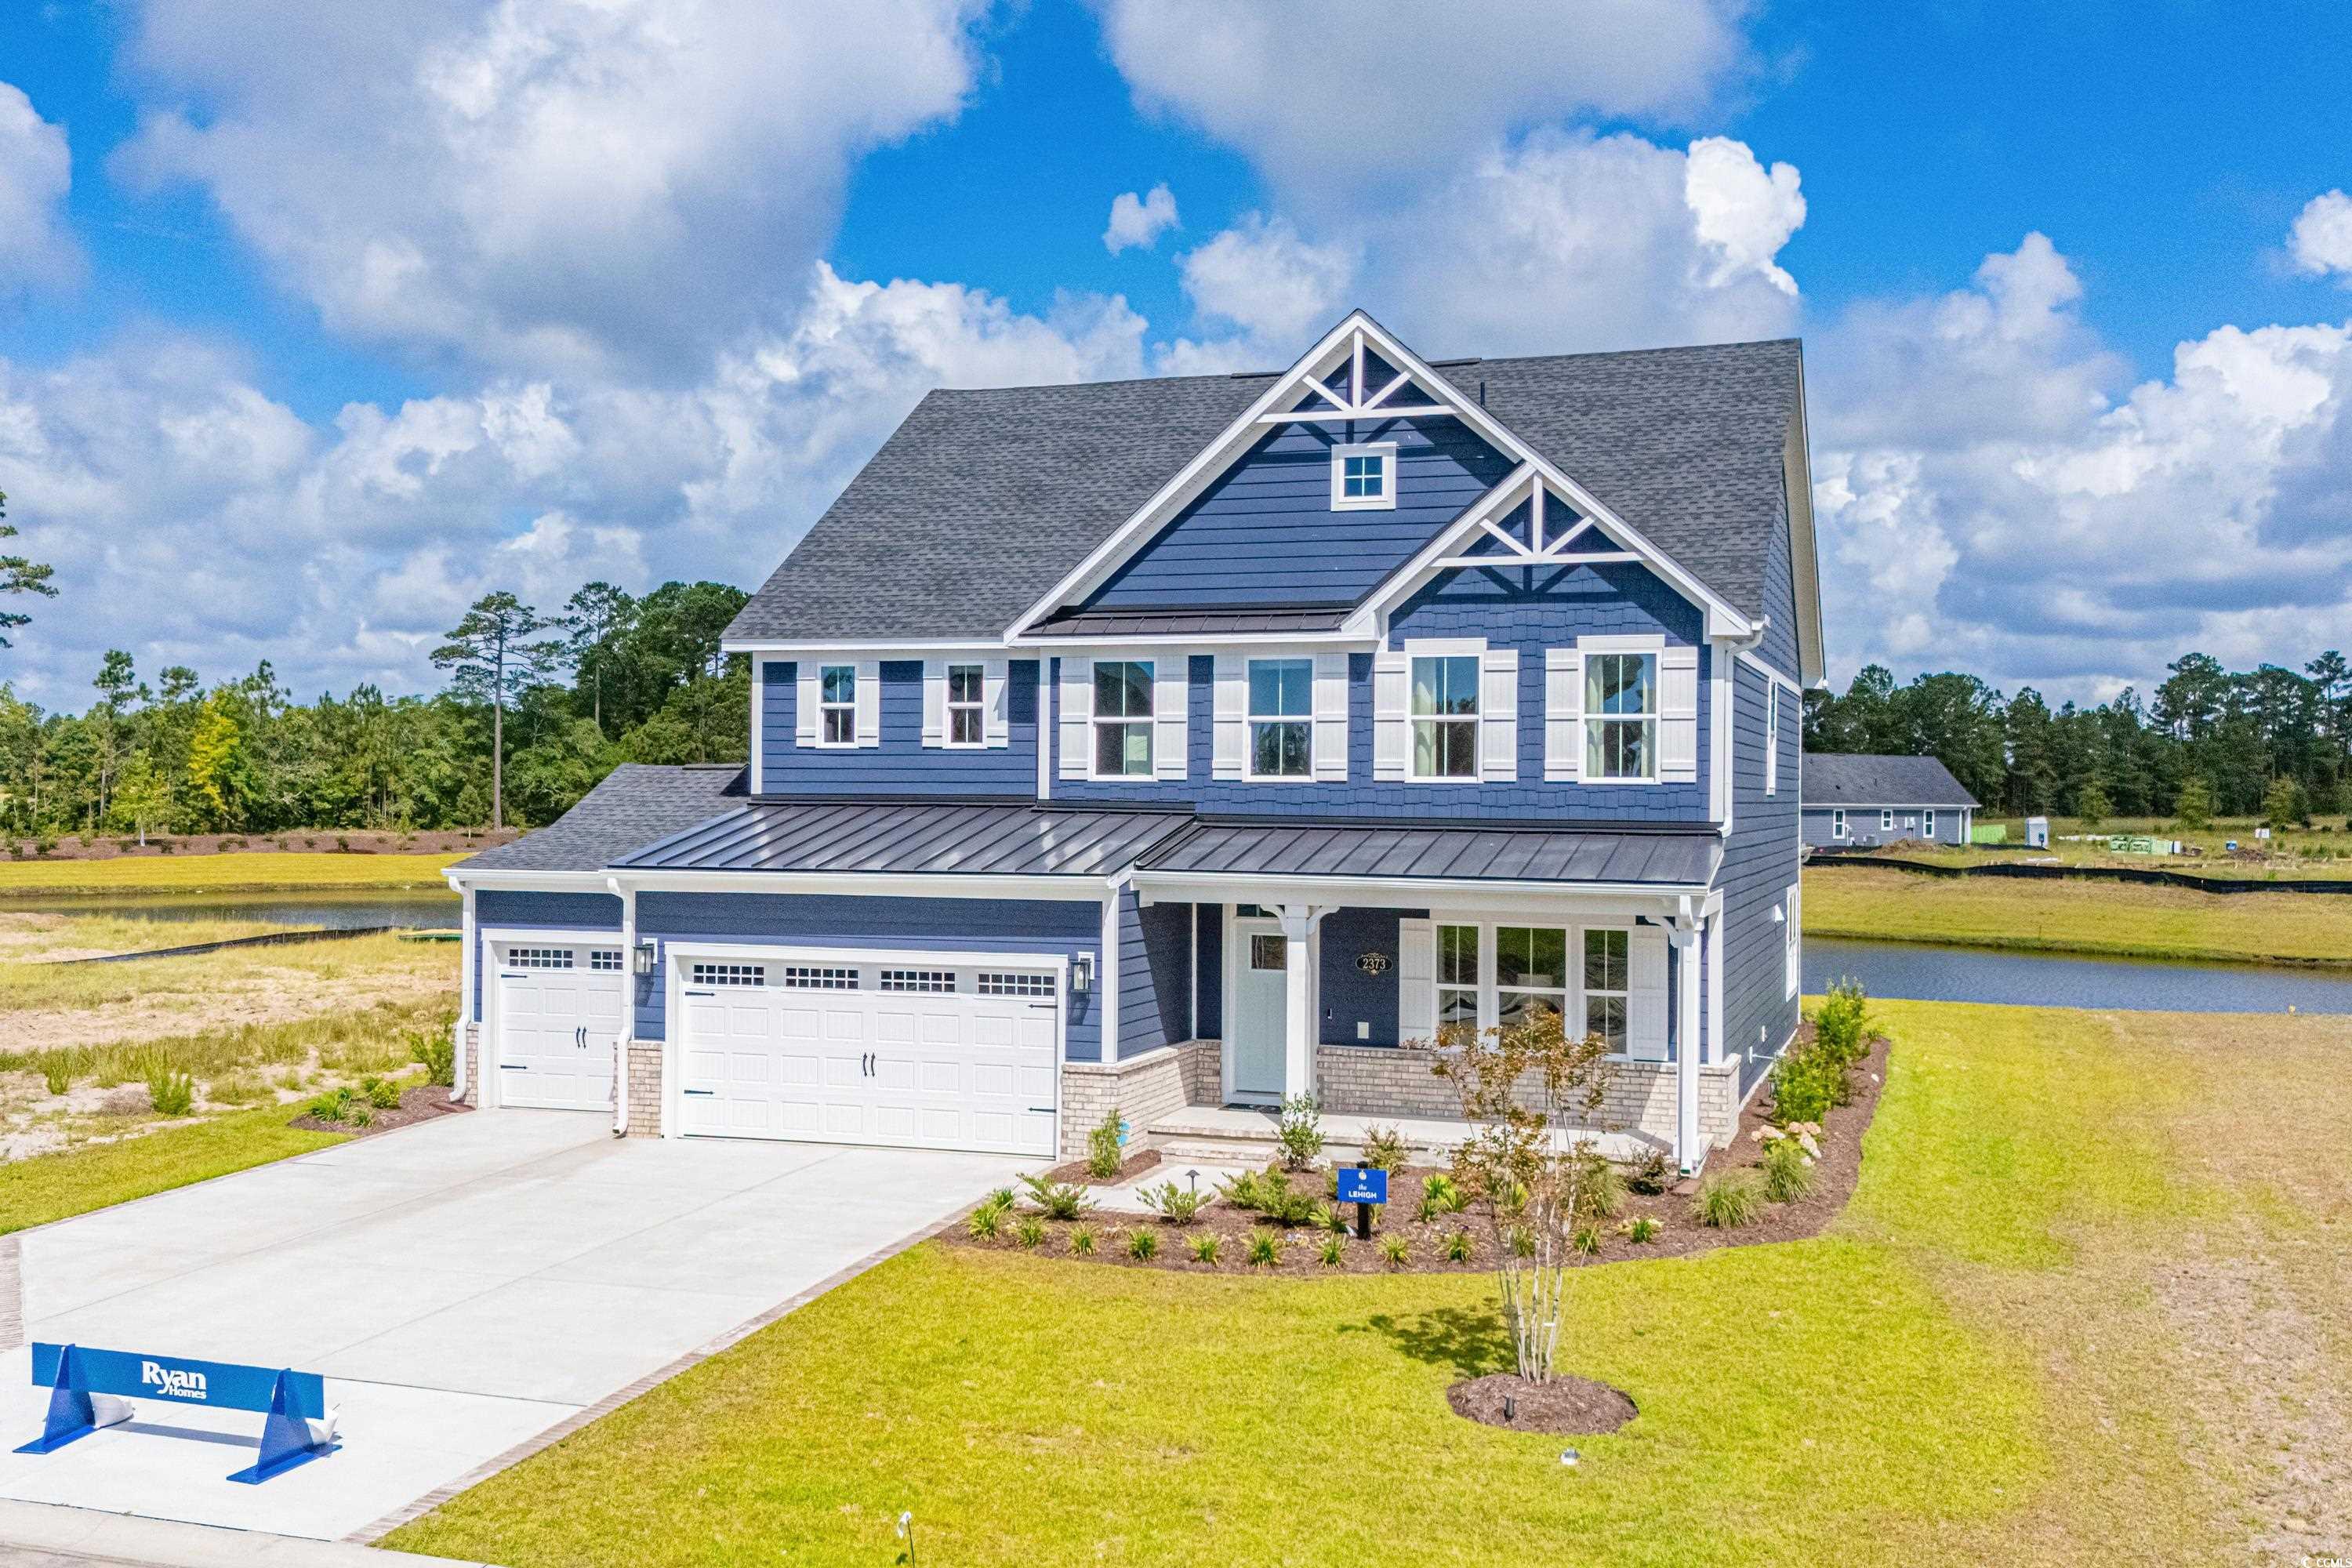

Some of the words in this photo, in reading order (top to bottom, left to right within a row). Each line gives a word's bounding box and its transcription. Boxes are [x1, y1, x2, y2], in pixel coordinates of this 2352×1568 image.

[1363, 958, 1385, 969] 2373
[142, 1361, 207, 1394] Ryan
[169, 1385, 207, 1399] Homes
